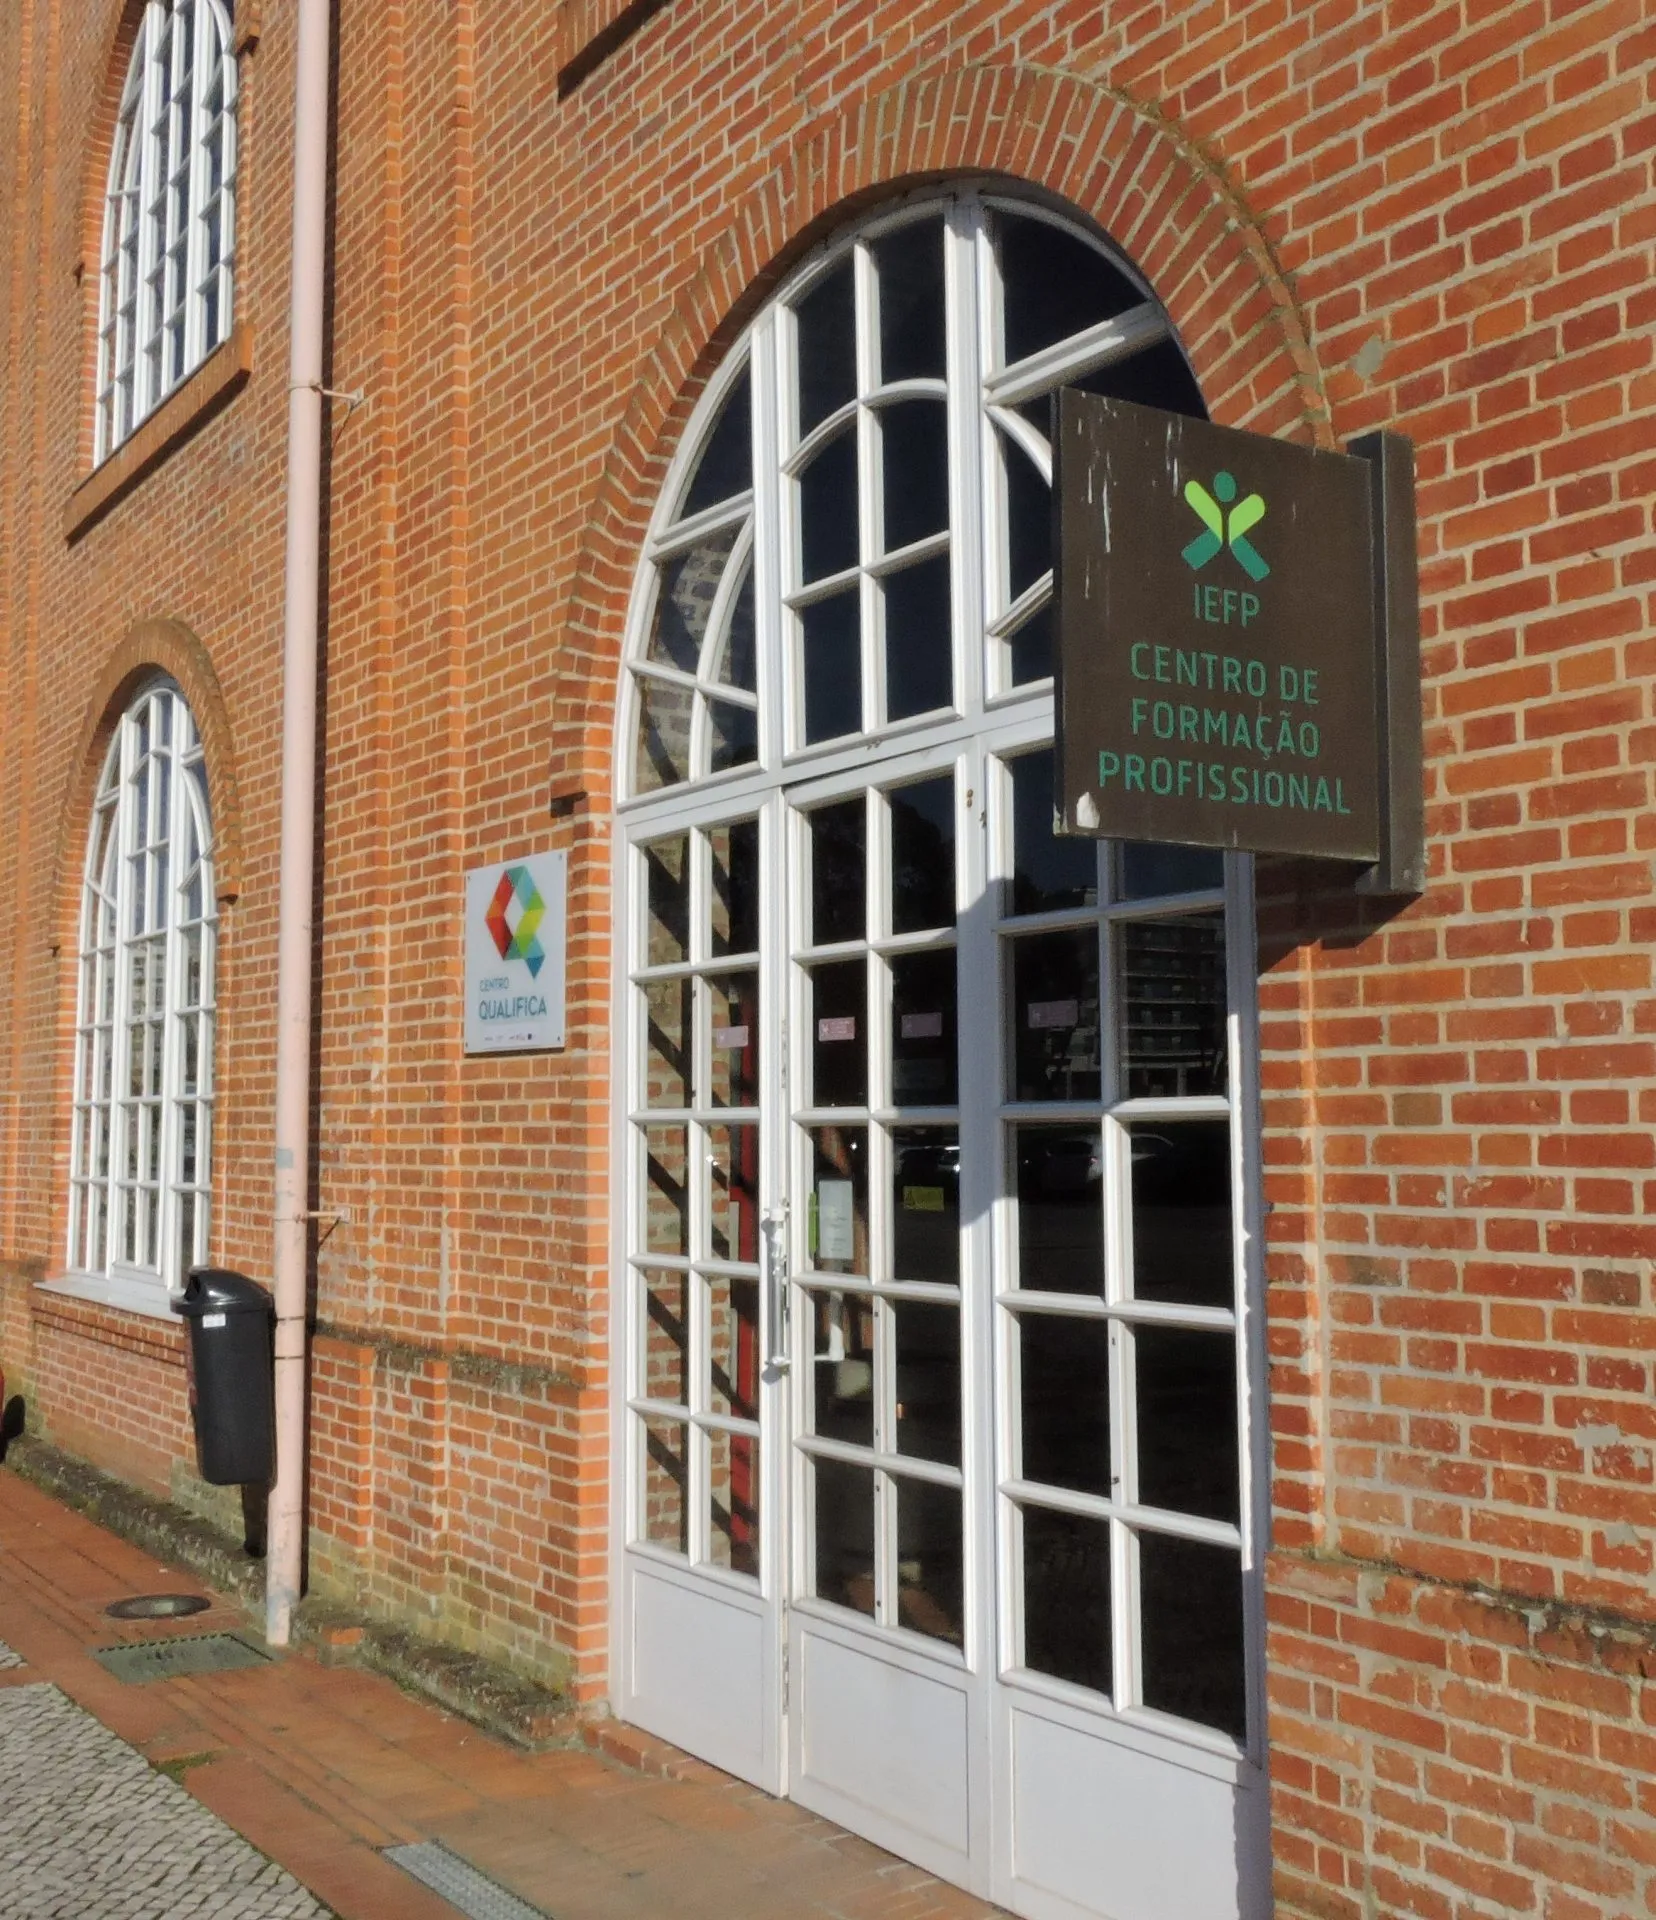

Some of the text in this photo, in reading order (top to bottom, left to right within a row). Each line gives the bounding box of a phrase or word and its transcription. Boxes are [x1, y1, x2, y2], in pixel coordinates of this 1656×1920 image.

[1194, 583, 1261, 628] IEFP
[1131, 642, 1319, 704] CENTRO DE
[1131, 698, 1321, 760] FORMAÇÃO
[1099, 751, 1351, 814] PROFISSIONAL
[479, 977, 510, 992] CENTRO
[479, 996, 547, 1020] QUALIFICA
